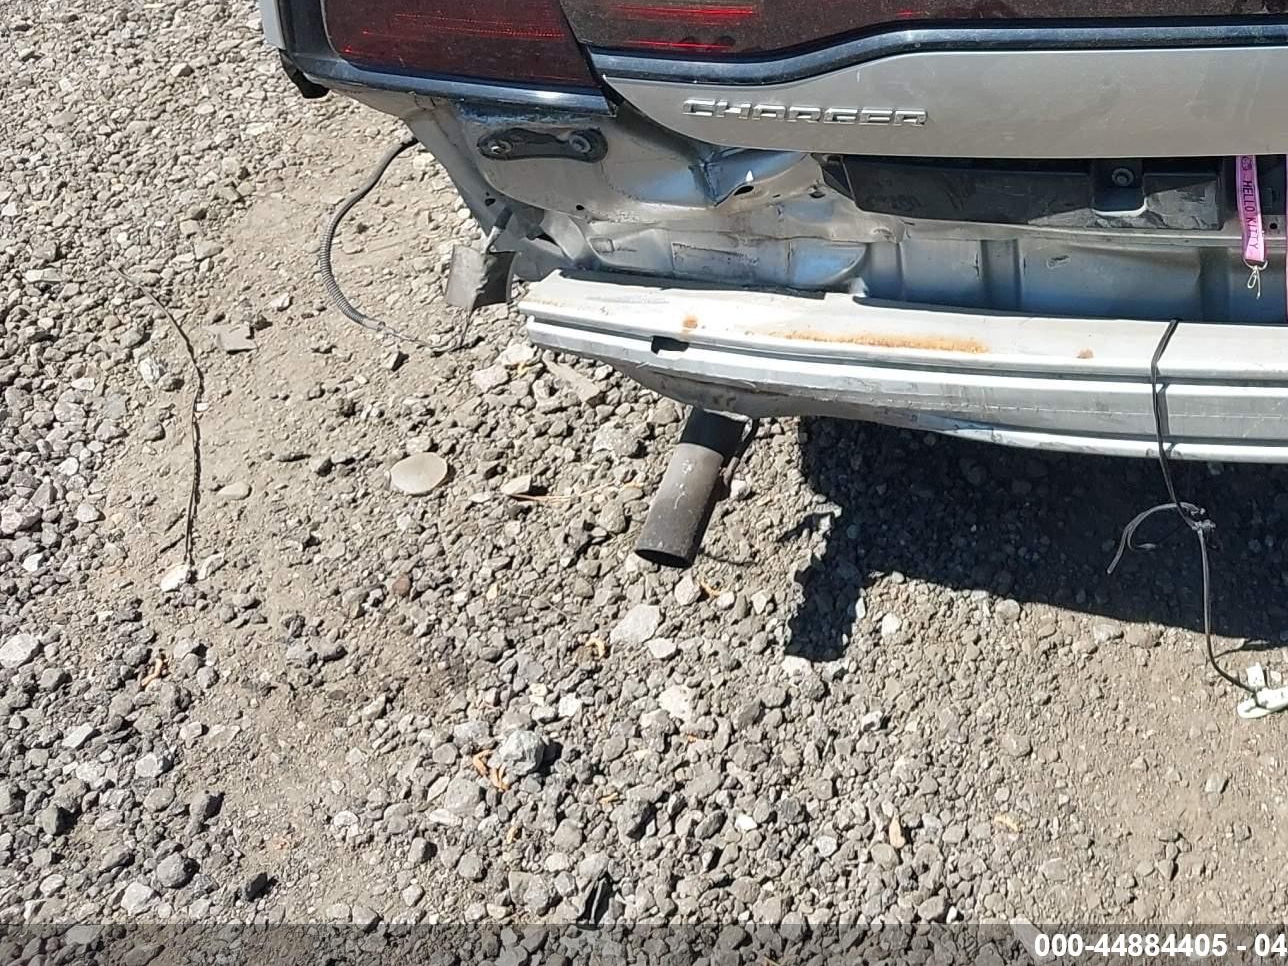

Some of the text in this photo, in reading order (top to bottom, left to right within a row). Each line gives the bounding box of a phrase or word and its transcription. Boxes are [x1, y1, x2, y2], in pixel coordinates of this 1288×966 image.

[682, 98, 929, 127] CHARGER
[1242, 180, 1258, 250] HELLO KITTY
